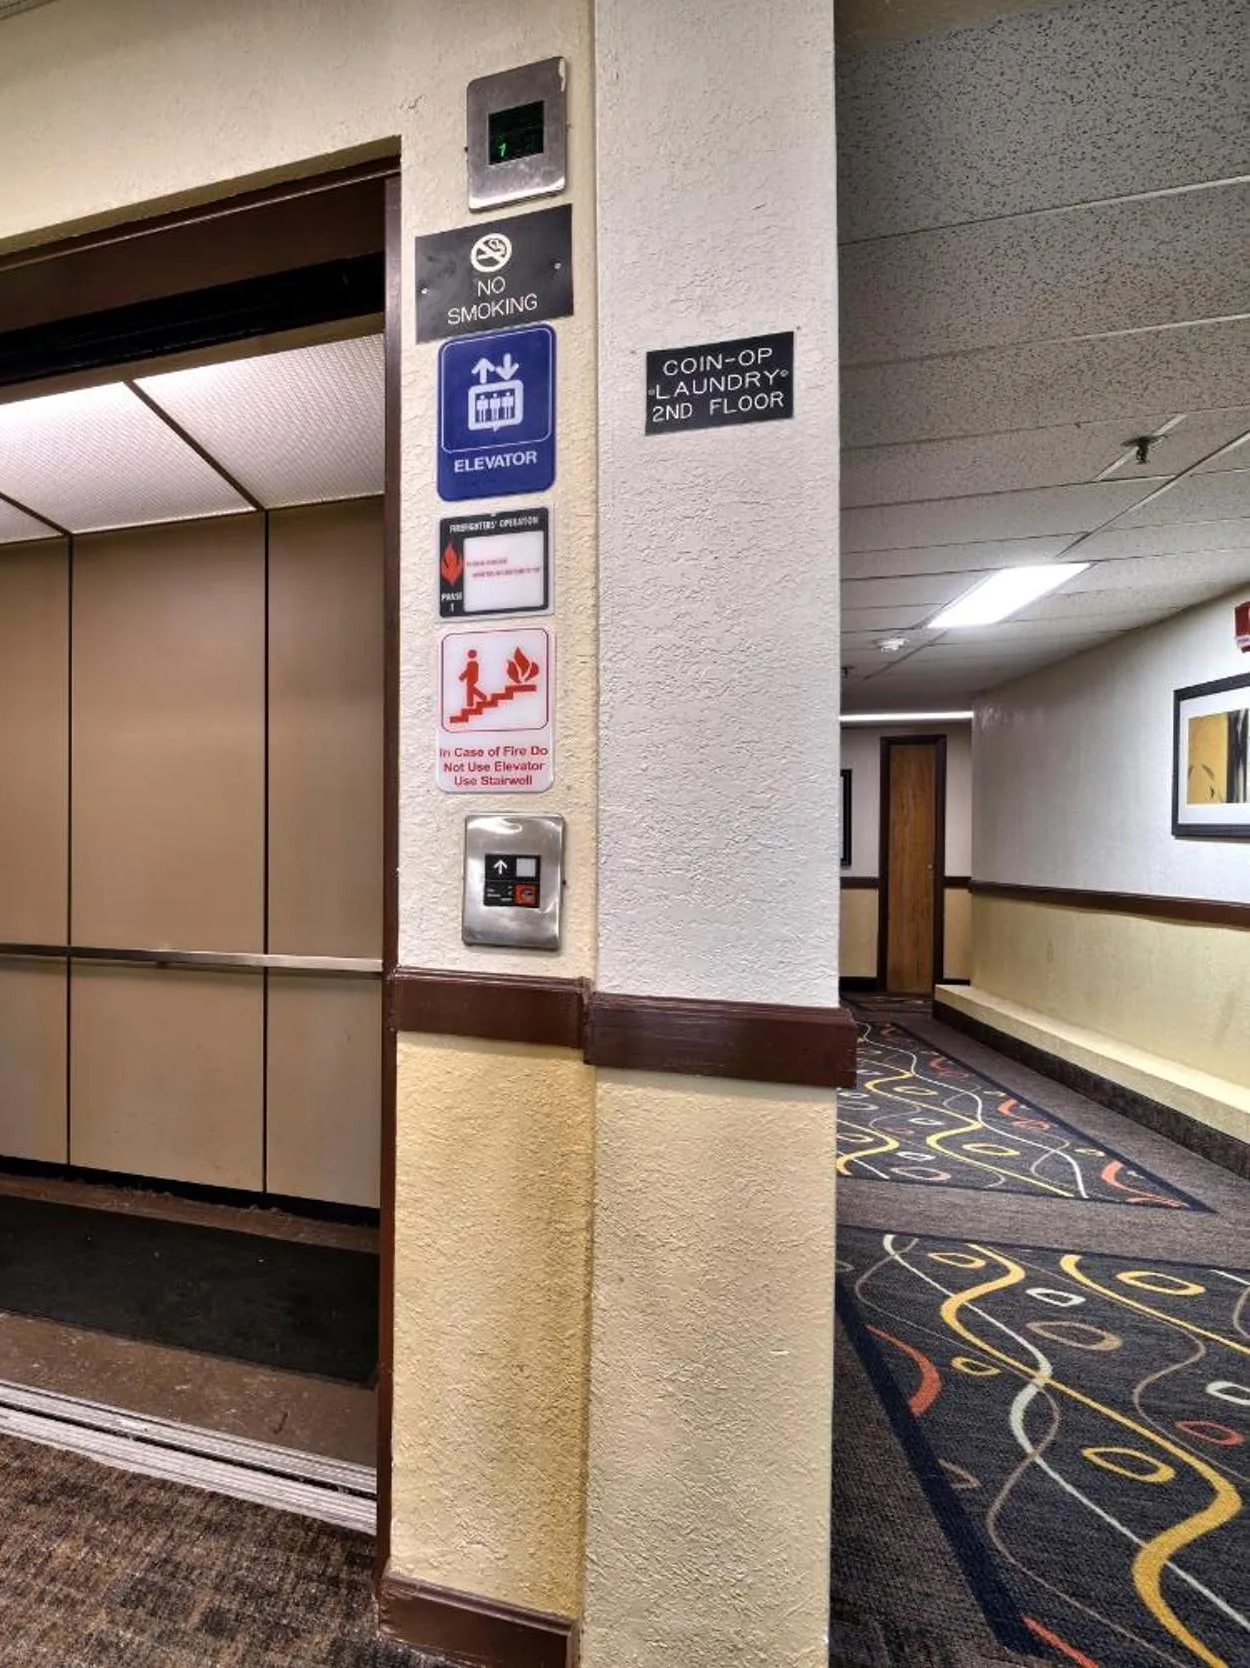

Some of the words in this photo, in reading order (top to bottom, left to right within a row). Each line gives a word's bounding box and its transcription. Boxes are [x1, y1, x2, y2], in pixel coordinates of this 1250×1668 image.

[478, 276, 506, 297] NO
[448, 293, 538, 325] SMOKING
[663, 347, 772, 376] COIN-OP
[656, 369, 779, 399] LAUNDRY
[652, 402, 692, 422] 2ND
[710, 391, 784, 415] FLOOR
[454, 451, 537, 472] ELEVATOR
[499, 516, 539, 528] OPERATION
[439, 747, 450, 757] In
[454, 747, 484, 757] Case
[488, 746, 500, 756] of
[503, 746, 527, 756] Fire
[530, 745, 548, 756] Do
[444, 762, 464, 772] Not
[468, 762, 490, 772] Use
[494, 760, 545, 772] Elevator
[454, 776, 477, 786] Use
[480, 774, 532, 786] Stairwell
